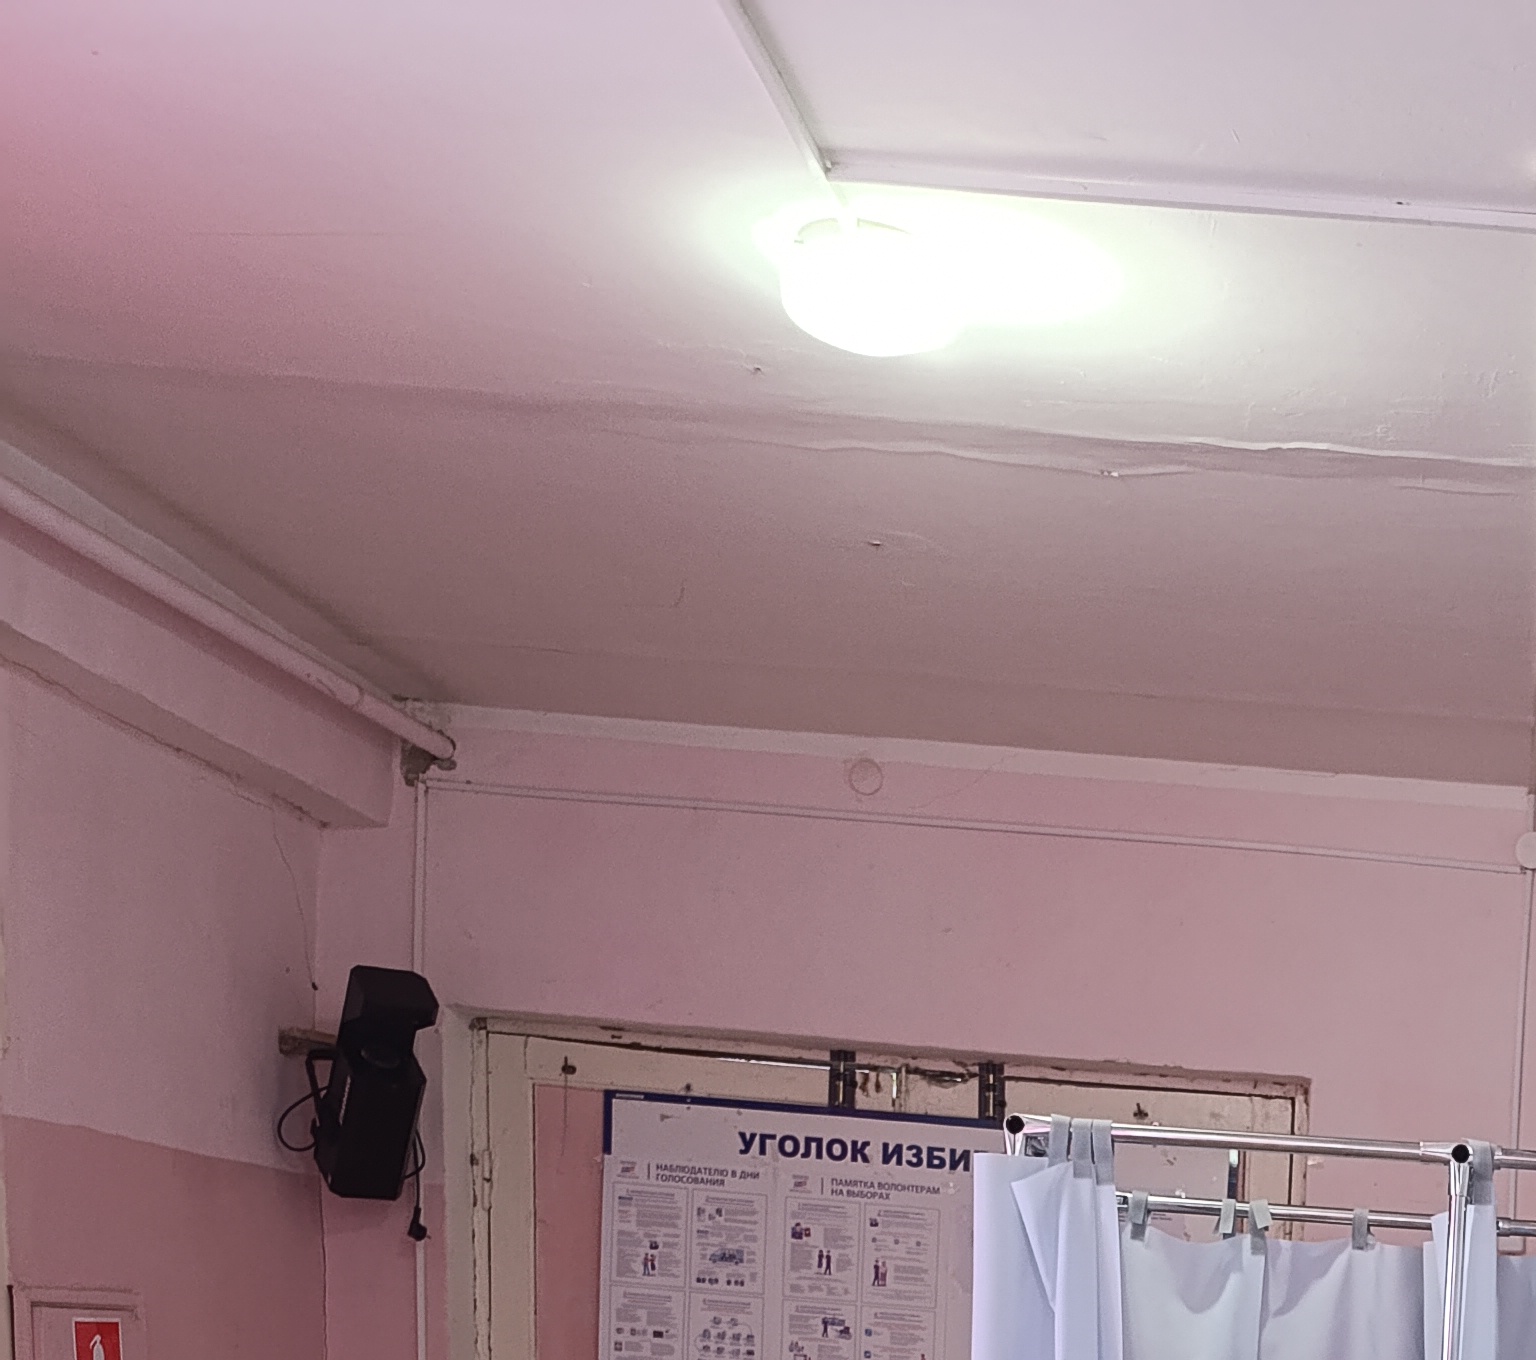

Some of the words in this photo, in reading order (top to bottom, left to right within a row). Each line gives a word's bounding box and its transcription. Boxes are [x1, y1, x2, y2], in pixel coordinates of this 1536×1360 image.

[738, 1131, 870, 1163] УГОЛОК
[881, 1142, 978, 1172] ИЗБИ
[656, 1163, 728, 1177] НАБЛЮДАТЕЛЮ
[738, 1171, 759, 1179] ДНИ
[656, 1175, 725, 1187] ГОЛОСОВАНИЯ
[831, 1178, 875, 1190] ПАМЯТКА
[877, 1183, 940, 1195] ВОЛОНТЕРАМ
[846, 1191, 890, 1200] ВЫБОРАХ
